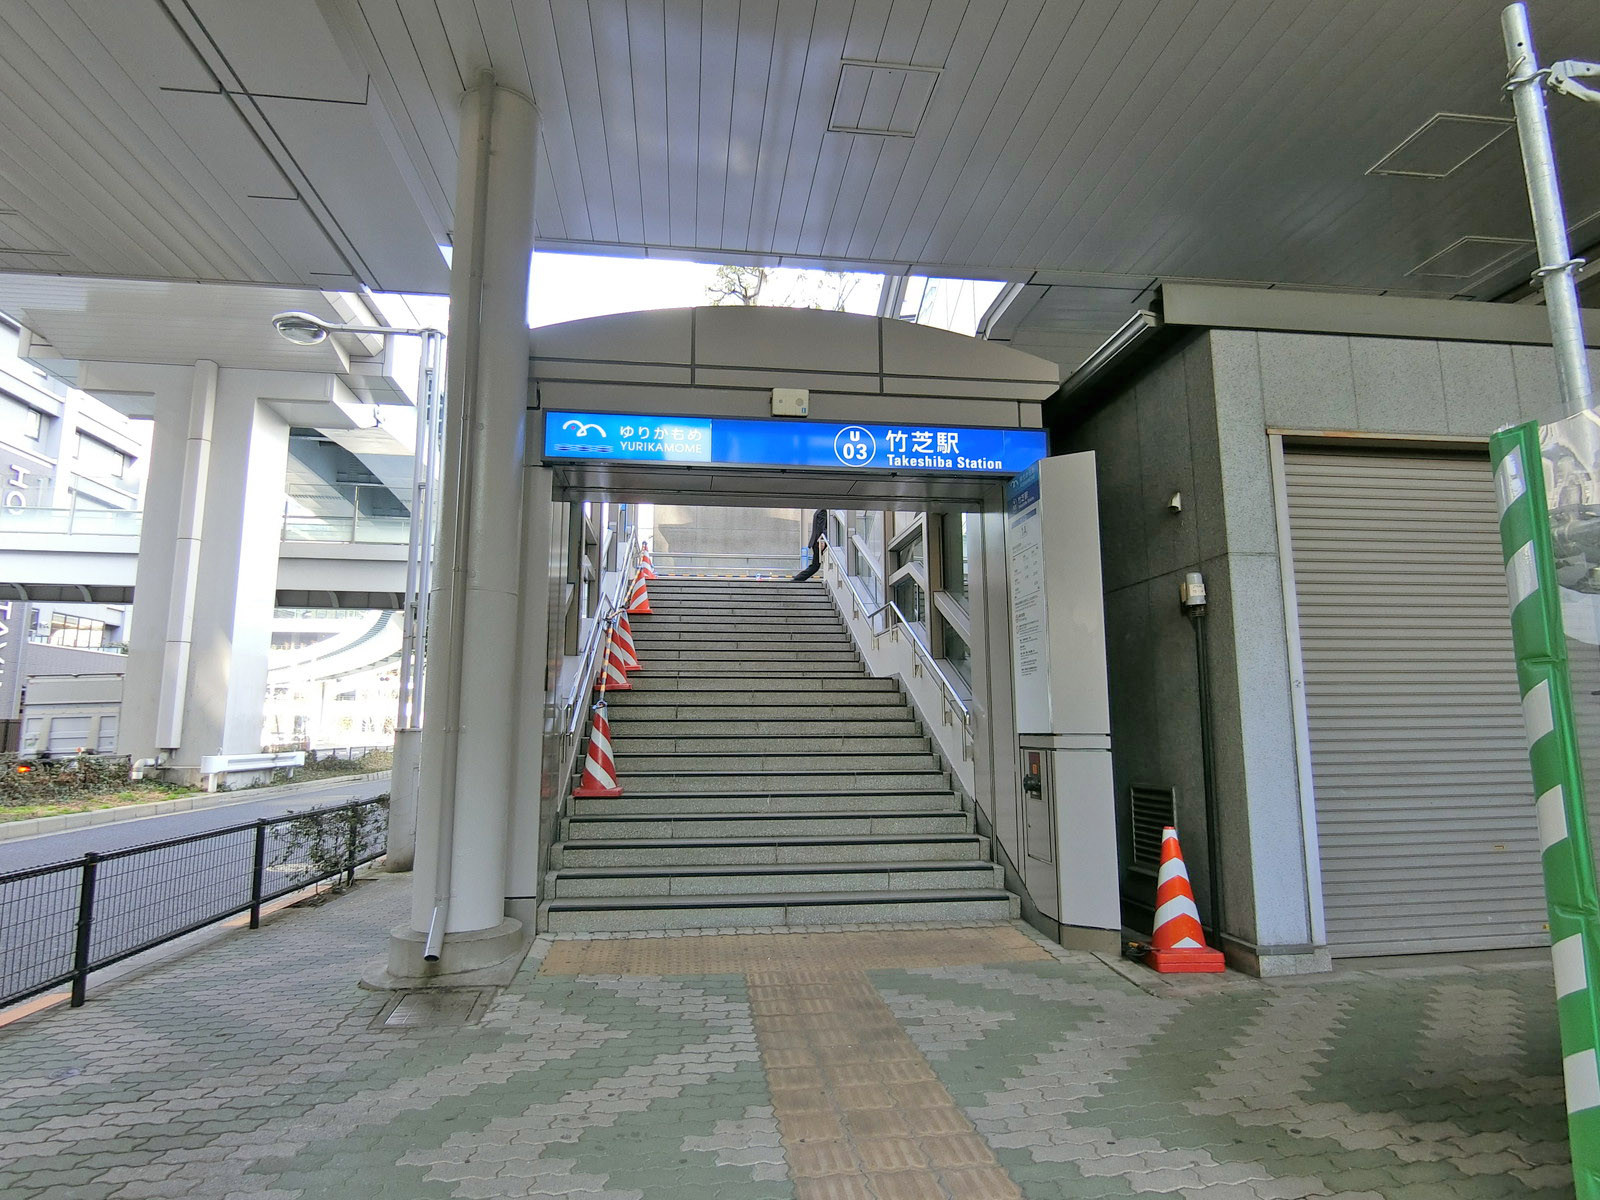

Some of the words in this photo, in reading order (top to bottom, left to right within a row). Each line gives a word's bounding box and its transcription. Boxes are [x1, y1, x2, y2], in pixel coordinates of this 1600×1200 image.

[620, 425, 702, 441] ゆりかもめ
[850, 431, 860, 442] U
[620, 441, 702, 454] YURIKAMOME
[885, 429, 959, 454] 竹芝駅
[843, 443, 868, 460] 03
[886, 454, 952, 468] Takeshiba
[957, 456, 1002, 469] Station
